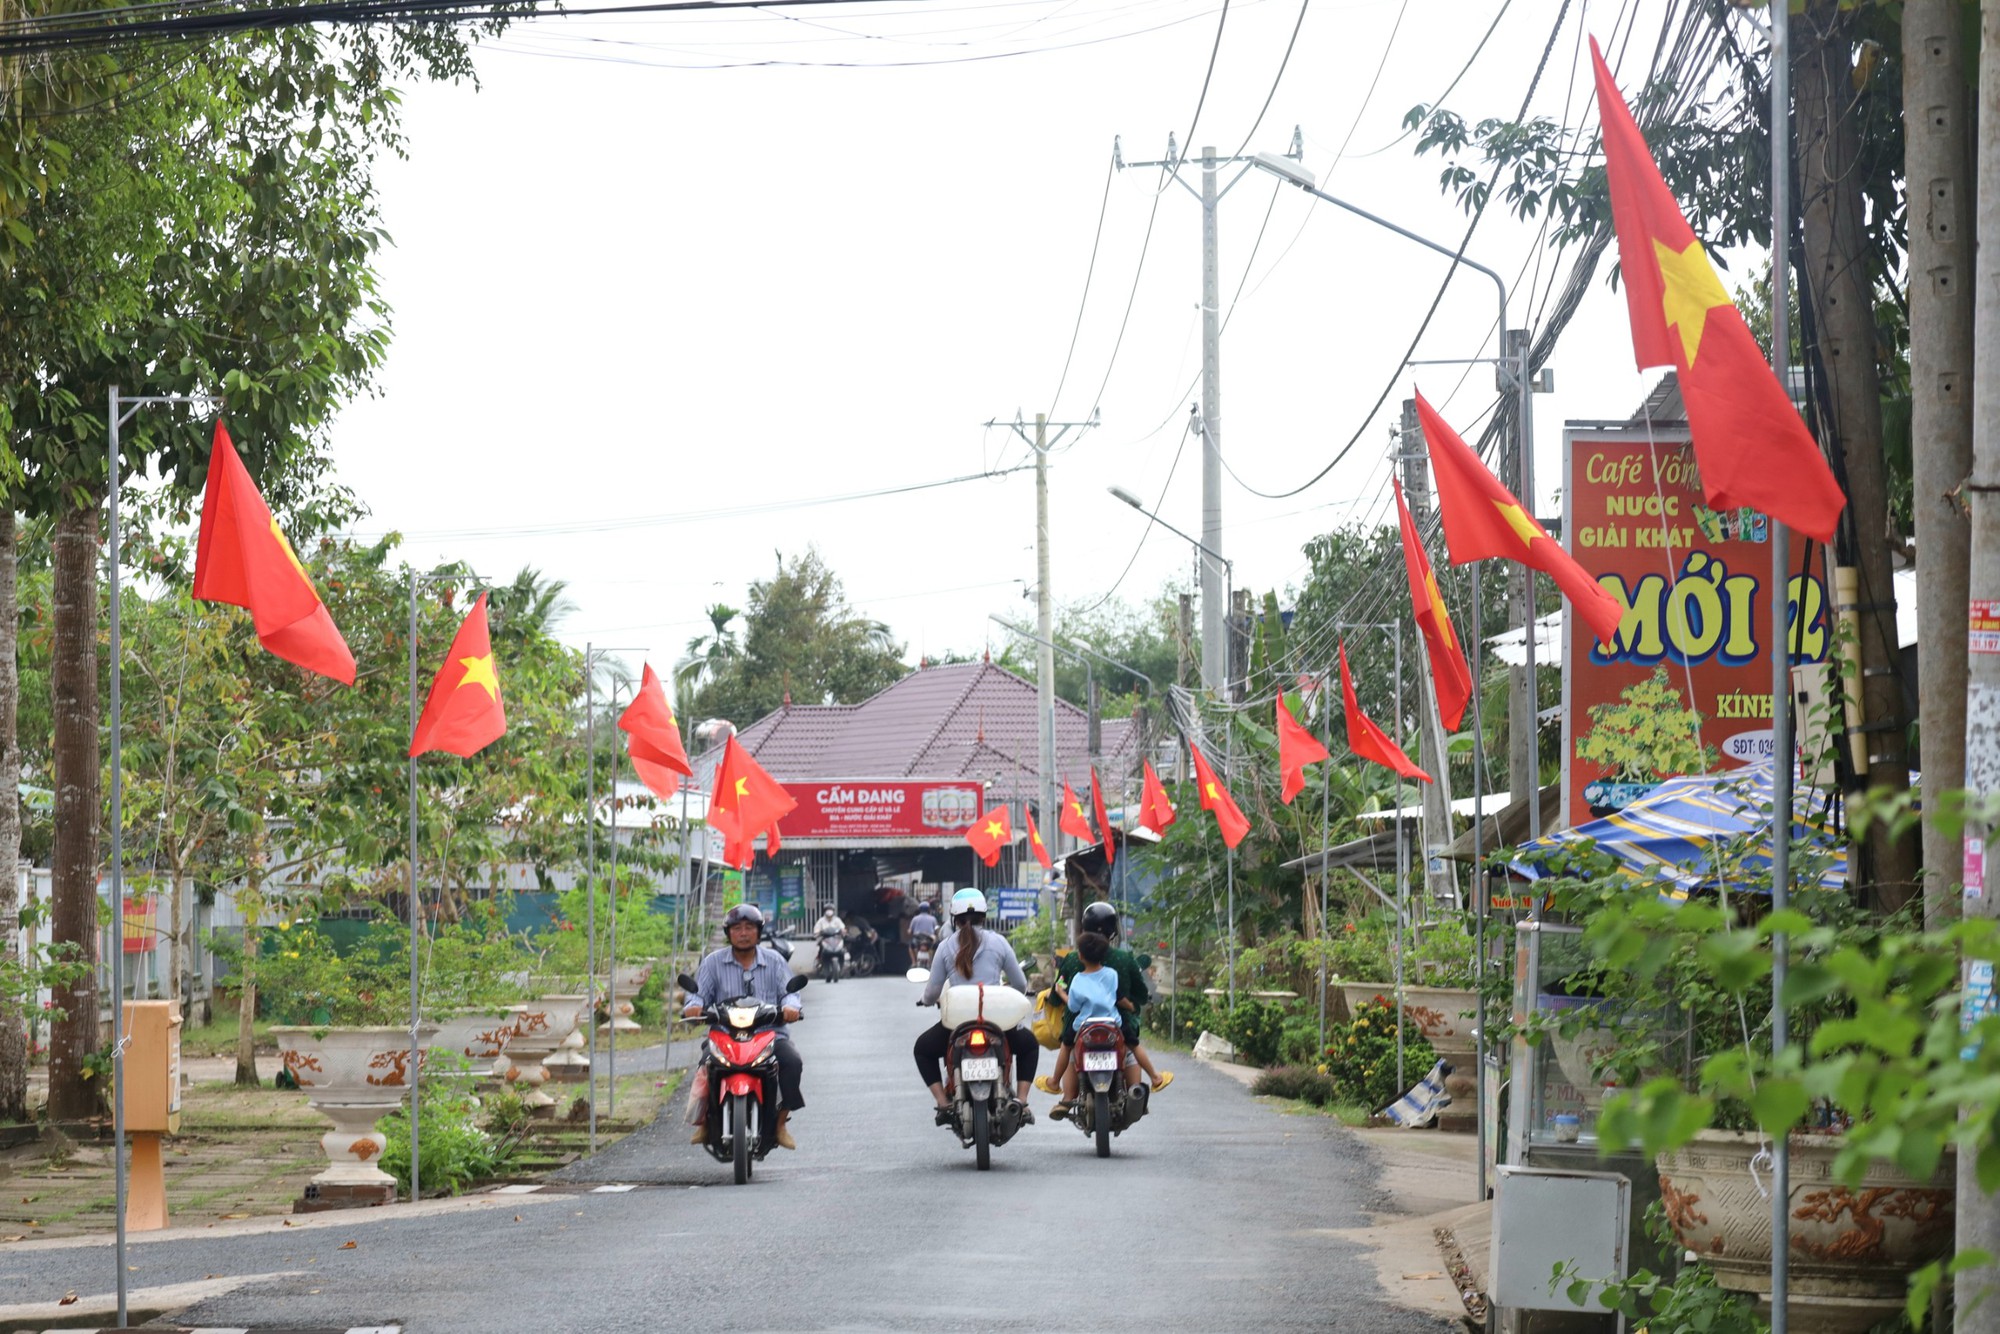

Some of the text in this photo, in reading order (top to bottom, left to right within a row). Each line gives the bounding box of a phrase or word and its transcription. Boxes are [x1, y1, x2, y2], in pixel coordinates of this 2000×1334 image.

[1586, 453, 1700, 491] Café Võn
[1606, 491, 1679, 516] NƯỚC
[1579, 522, 1694, 548] GIẢI KHÁT
[1592, 550, 1759, 664] MỚI
[1717, 688, 1774, 718] KÍNH
[1733, 739, 1755, 754] SĐT:
[858, 789, 905, 804] ĐANG
